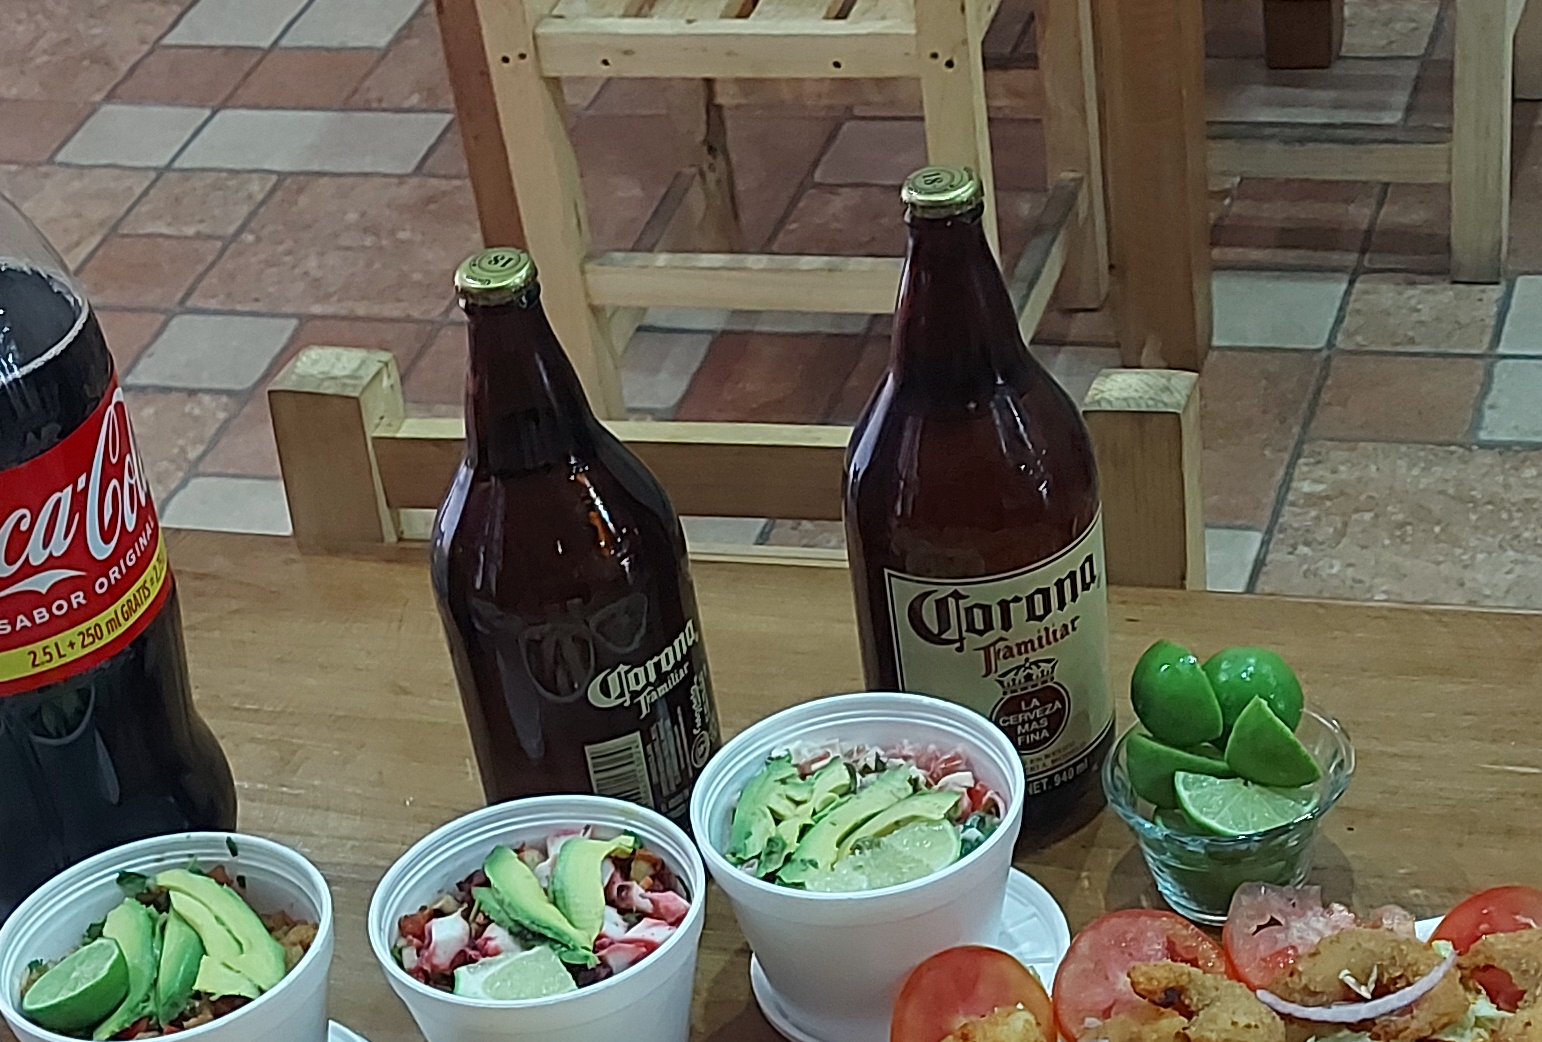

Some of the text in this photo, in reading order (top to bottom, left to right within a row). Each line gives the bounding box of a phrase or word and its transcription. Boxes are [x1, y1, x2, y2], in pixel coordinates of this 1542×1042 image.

[95, 514, 155, 595] ORIGINAL
[55, 641, 67, 660] L
[76, 622, 104, 650] 250
[104, 609, 123, 636] ml
[119, 581, 152, 622] GRATIS
[906, 552, 1099, 654] Corona
[587, 617, 700, 710] Corona
[972, 613, 1082, 679] Familiar
[633, 661, 690, 720] Familiar
[998, 699, 1063, 728] CERVEZA
[1020, 697, 1041, 711] LA
[1016, 716, 1049, 736] MAS
[1017, 729, 1051, 747] FINA
[1053, 766, 1076, 787] 940
[1075, 756, 1089, 775] ml
